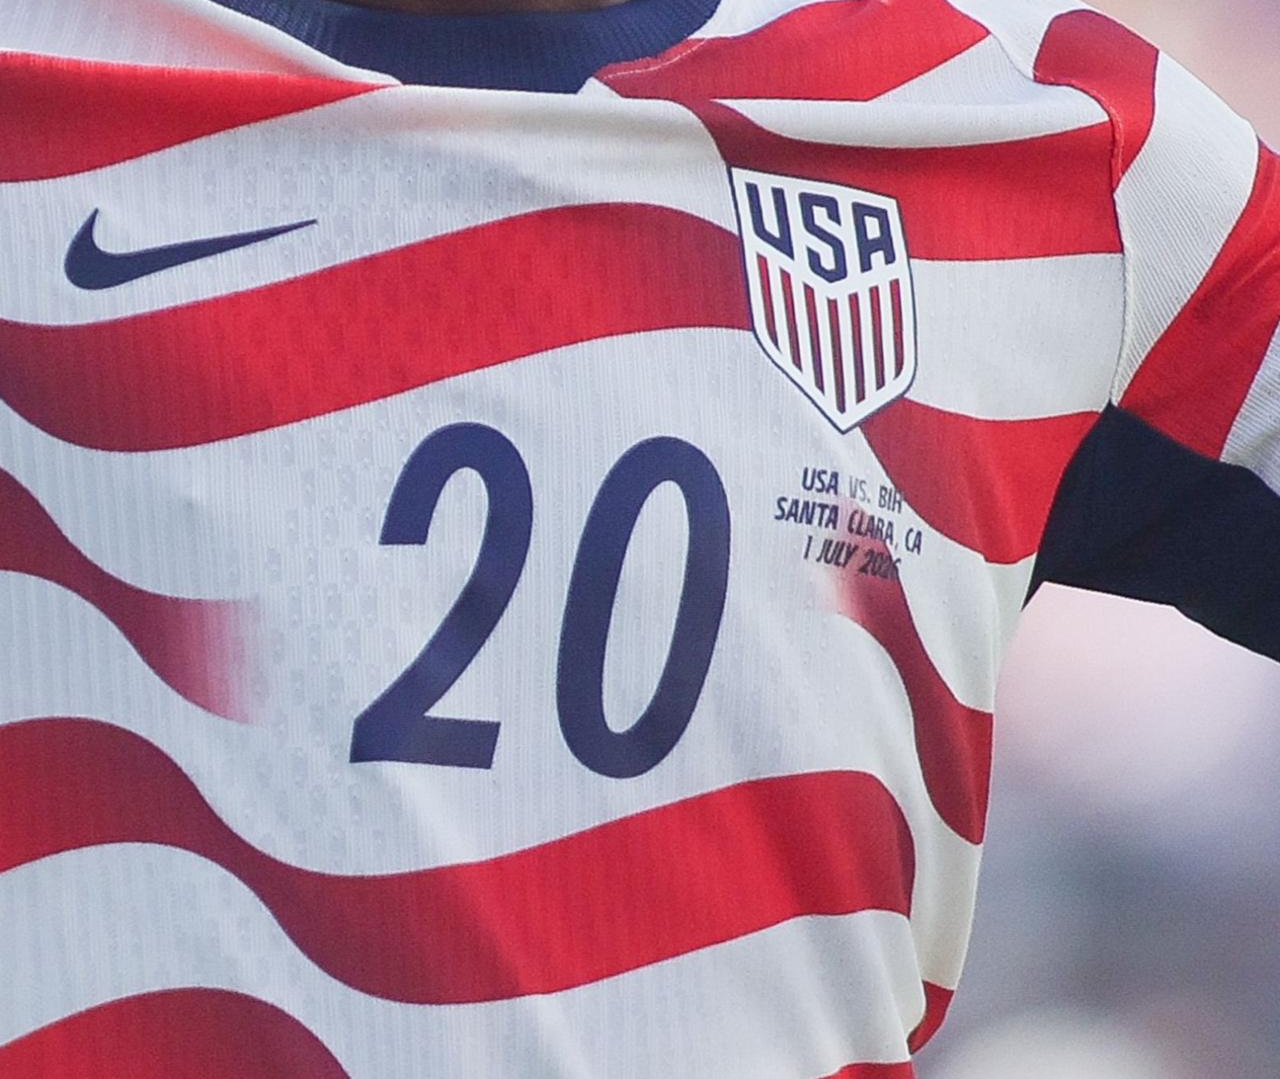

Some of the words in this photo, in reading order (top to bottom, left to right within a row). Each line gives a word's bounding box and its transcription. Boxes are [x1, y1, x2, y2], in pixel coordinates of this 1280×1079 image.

[744, 181, 897, 284] USA
[801, 467, 839, 496] USA
[848, 475, 871, 504] VS.
[774, 496, 839, 531] SANTA
[847, 508, 899, 551] CLARA,
[904, 527, 923, 556] CA
[803, 535, 813, 561] 1
[816, 538, 859, 569] JULY
[349, 421, 732, 779] 20
